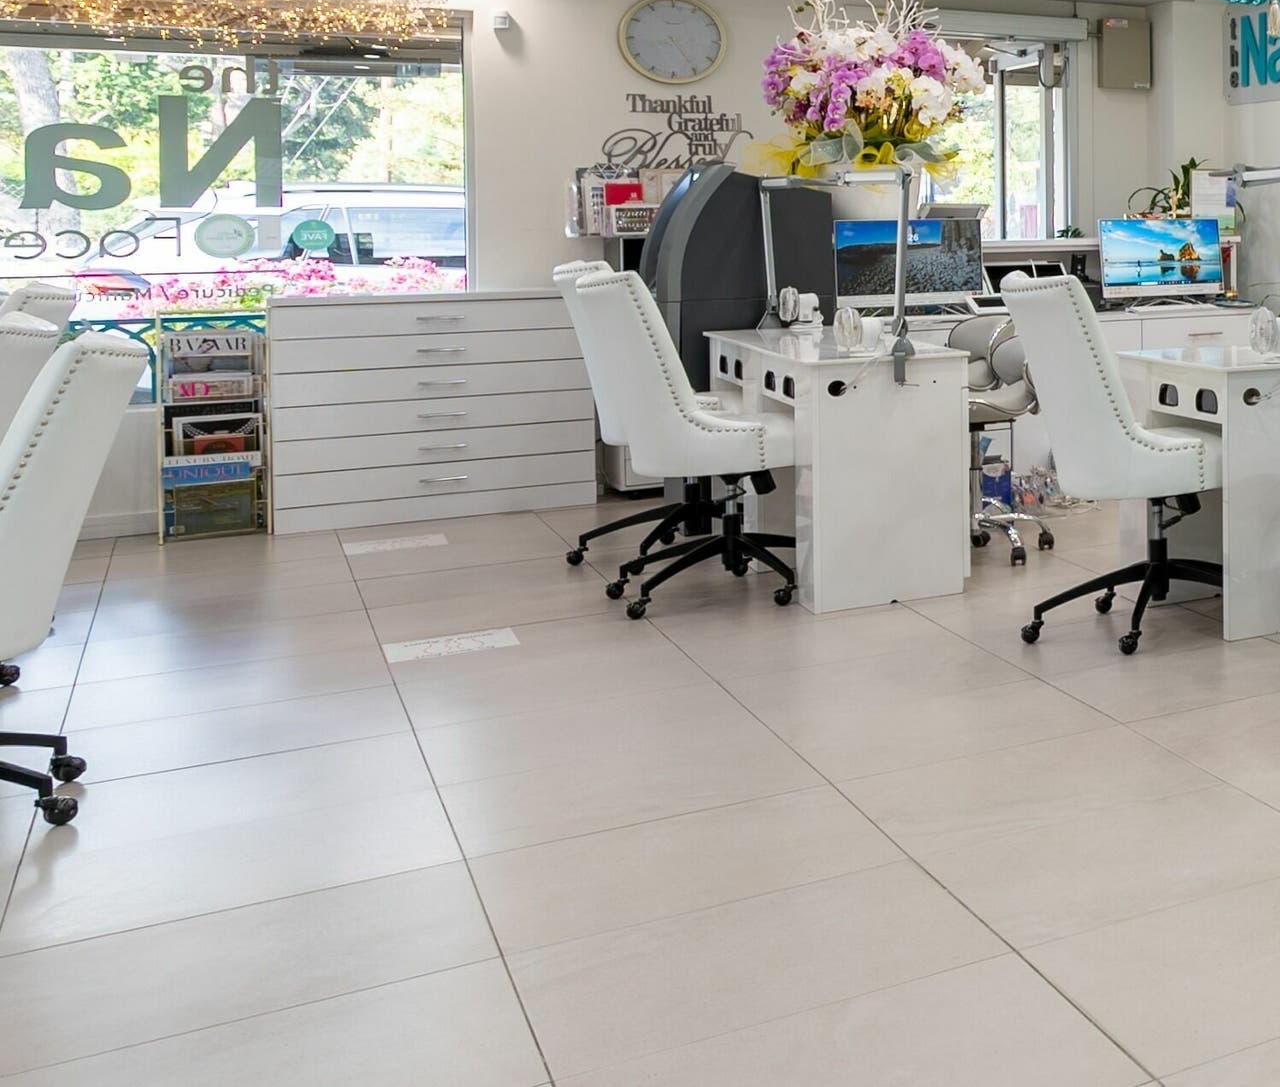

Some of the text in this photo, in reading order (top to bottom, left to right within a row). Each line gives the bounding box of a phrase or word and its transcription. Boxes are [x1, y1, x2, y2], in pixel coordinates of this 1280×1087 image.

[626, 93, 713, 113] Thankful
[667, 113, 742, 132] Grateful
[690, 131, 714, 142] and
[688, 141, 729, 160] truly
